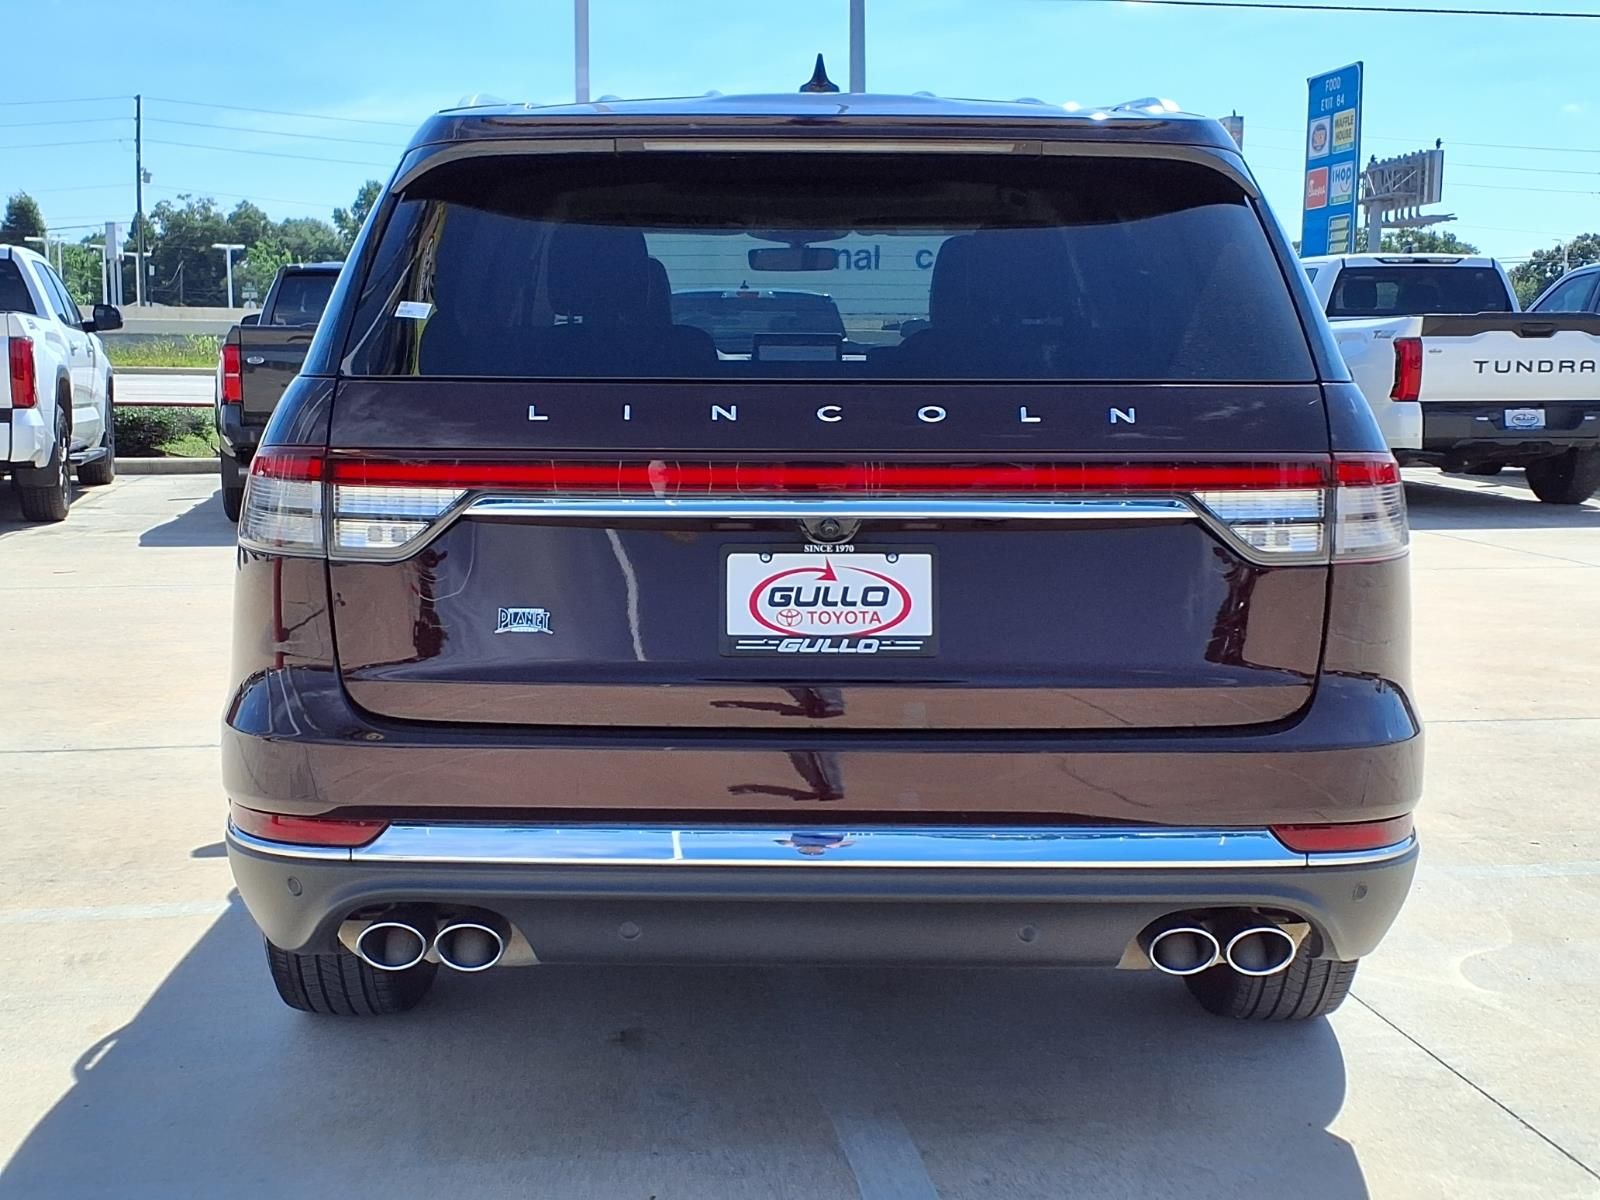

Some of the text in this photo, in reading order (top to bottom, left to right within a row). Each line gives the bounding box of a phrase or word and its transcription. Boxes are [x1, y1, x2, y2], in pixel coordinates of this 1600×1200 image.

[1325, 77, 1341, 93] FOOD
[1321, 94, 1345, 111] EXIT 84
[1335, 115, 1354, 129] WAFFLE
[833, 245, 880, 270] nal
[1473, 360, 1596, 374] TUNDRA
[527, 404, 1136, 425] LINCOLN
[804, 544, 855, 553] SINCE 1970
[768, 586, 890, 607] GULLO
[497, 607, 551, 630] PLANET
[808, 611, 882, 625] TOYOTA
[777, 638, 880, 654] GULLO
